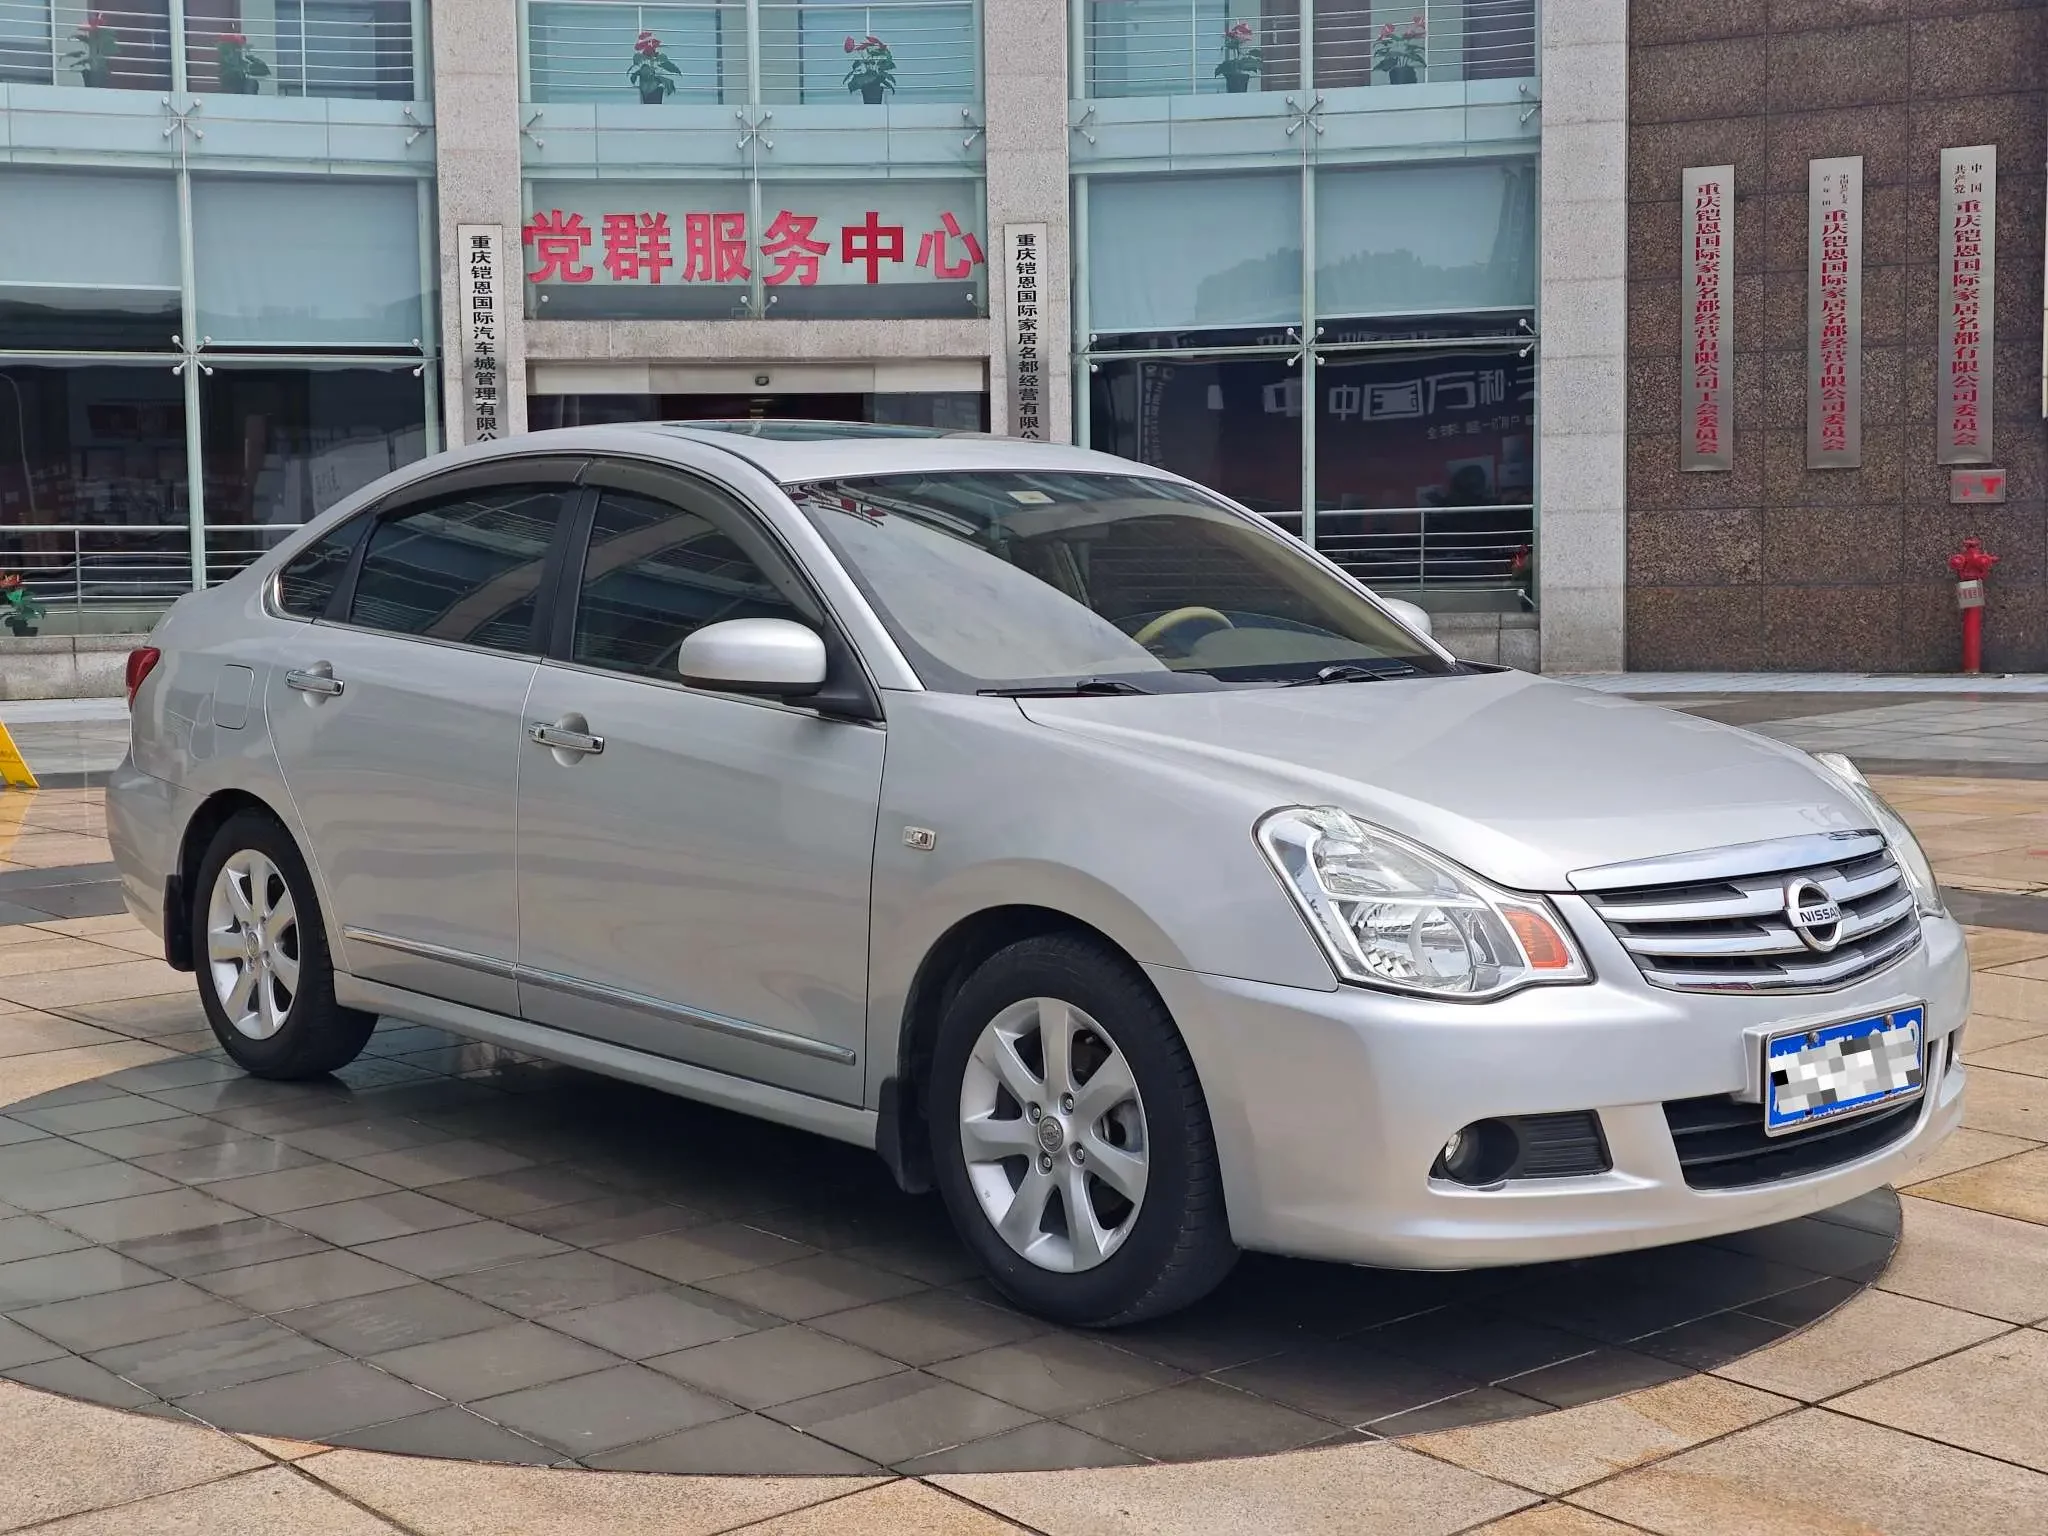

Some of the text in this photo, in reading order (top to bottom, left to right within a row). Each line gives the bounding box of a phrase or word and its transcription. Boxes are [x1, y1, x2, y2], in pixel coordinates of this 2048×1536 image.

[522, 209, 985, 286] 党群服务中心
